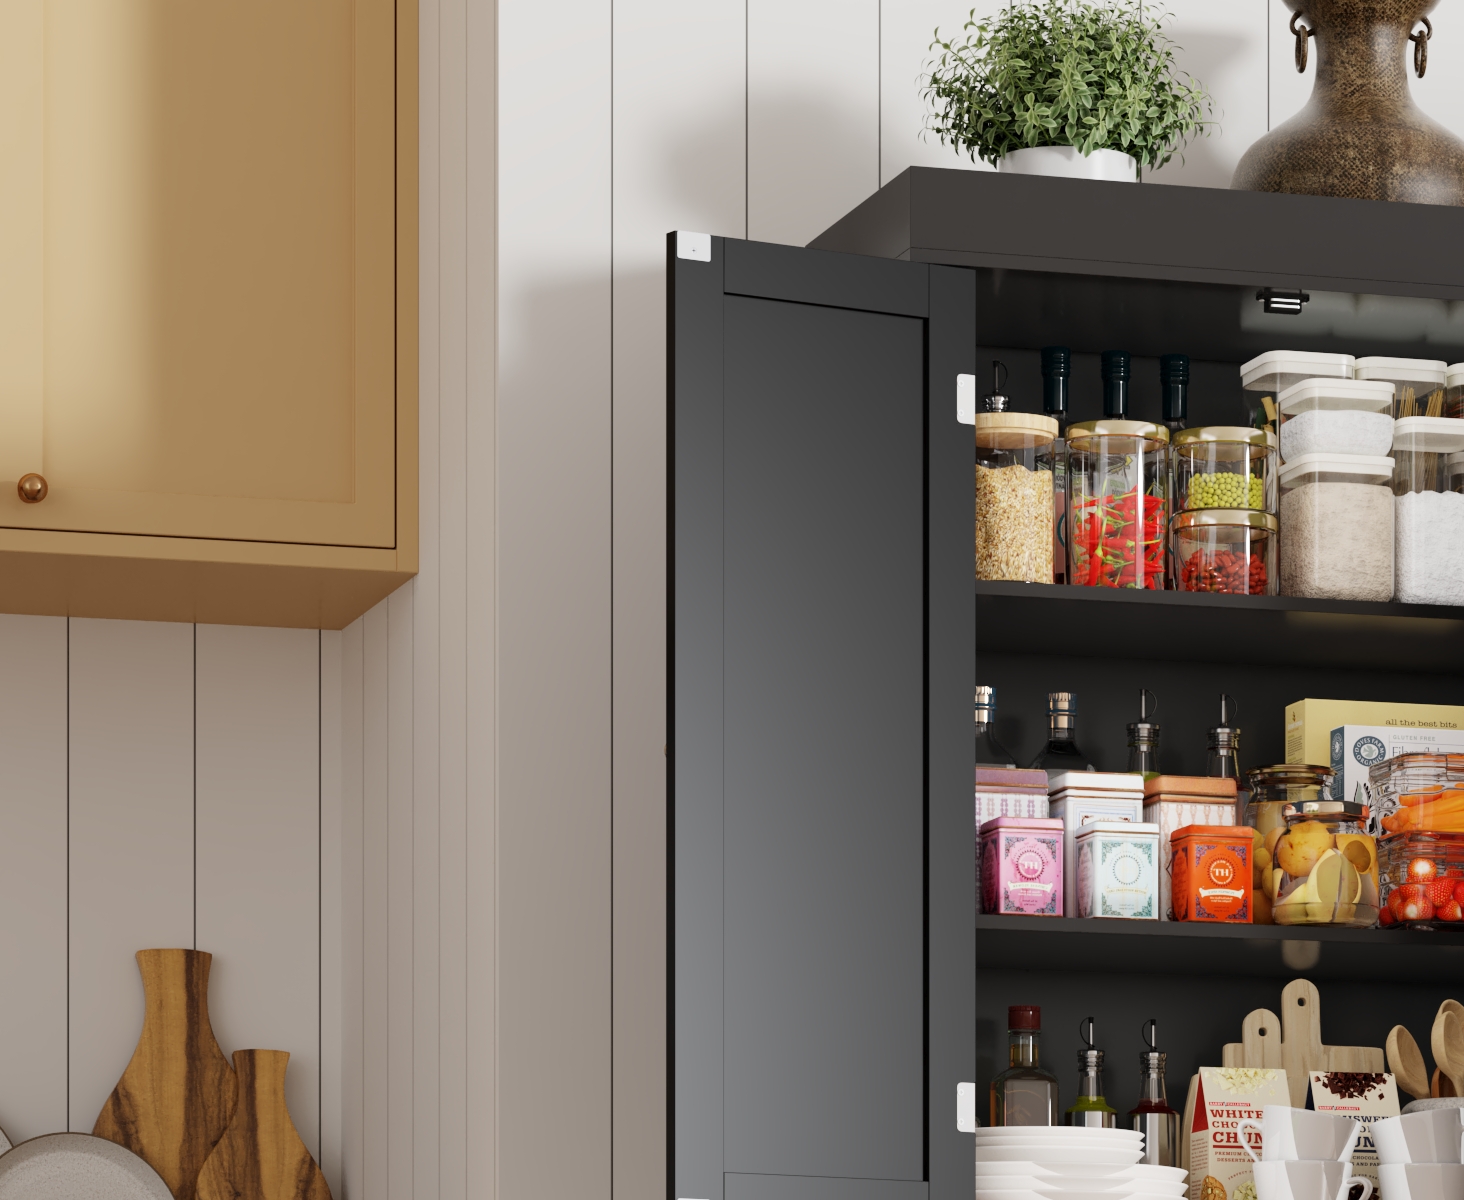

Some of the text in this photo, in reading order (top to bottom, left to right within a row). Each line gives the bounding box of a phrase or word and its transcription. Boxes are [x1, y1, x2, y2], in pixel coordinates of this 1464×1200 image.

[1385, 718, 1458, 729] all the best bits
[1210, 1109, 1263, 1119] WHITE
